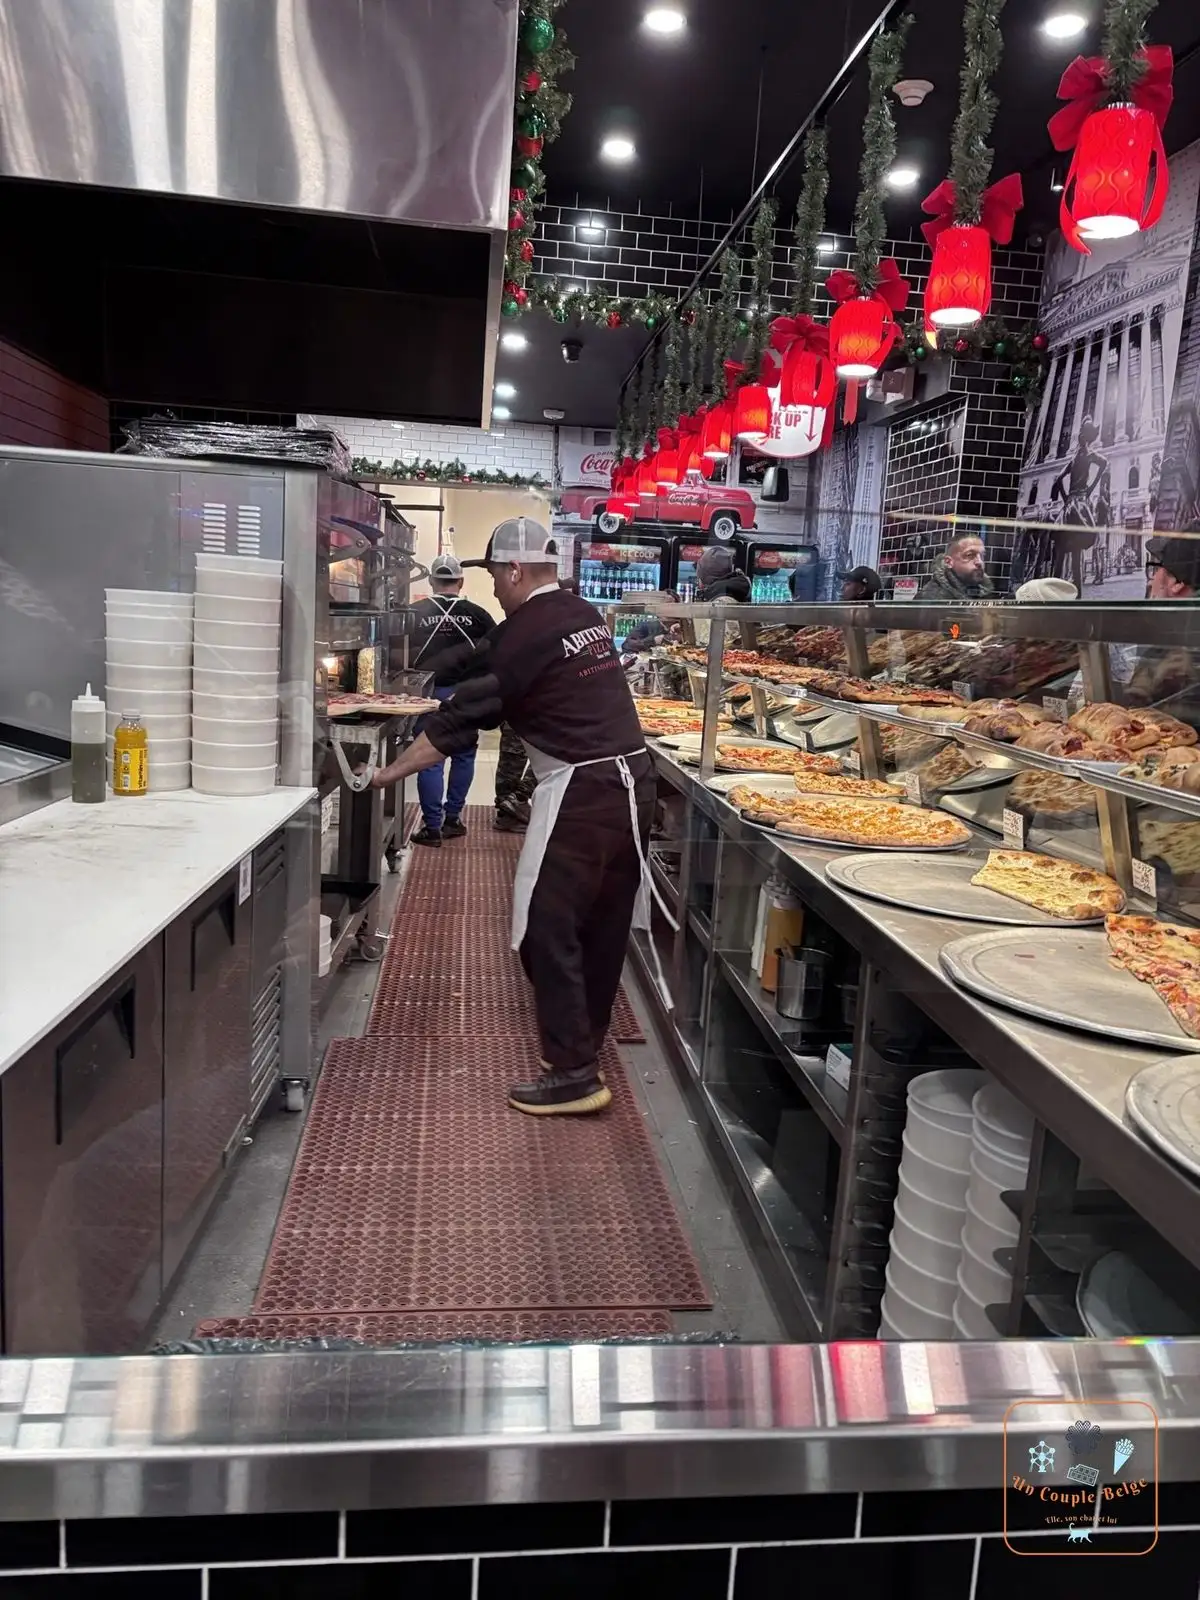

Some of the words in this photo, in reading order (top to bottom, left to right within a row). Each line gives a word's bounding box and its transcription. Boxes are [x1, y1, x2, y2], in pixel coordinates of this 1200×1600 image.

[785, 414, 802, 427] UP
[596, 449, 616, 457] DRIN
[620, 550, 633, 558] ICE
[561, 625, 612, 659] ABITINO
